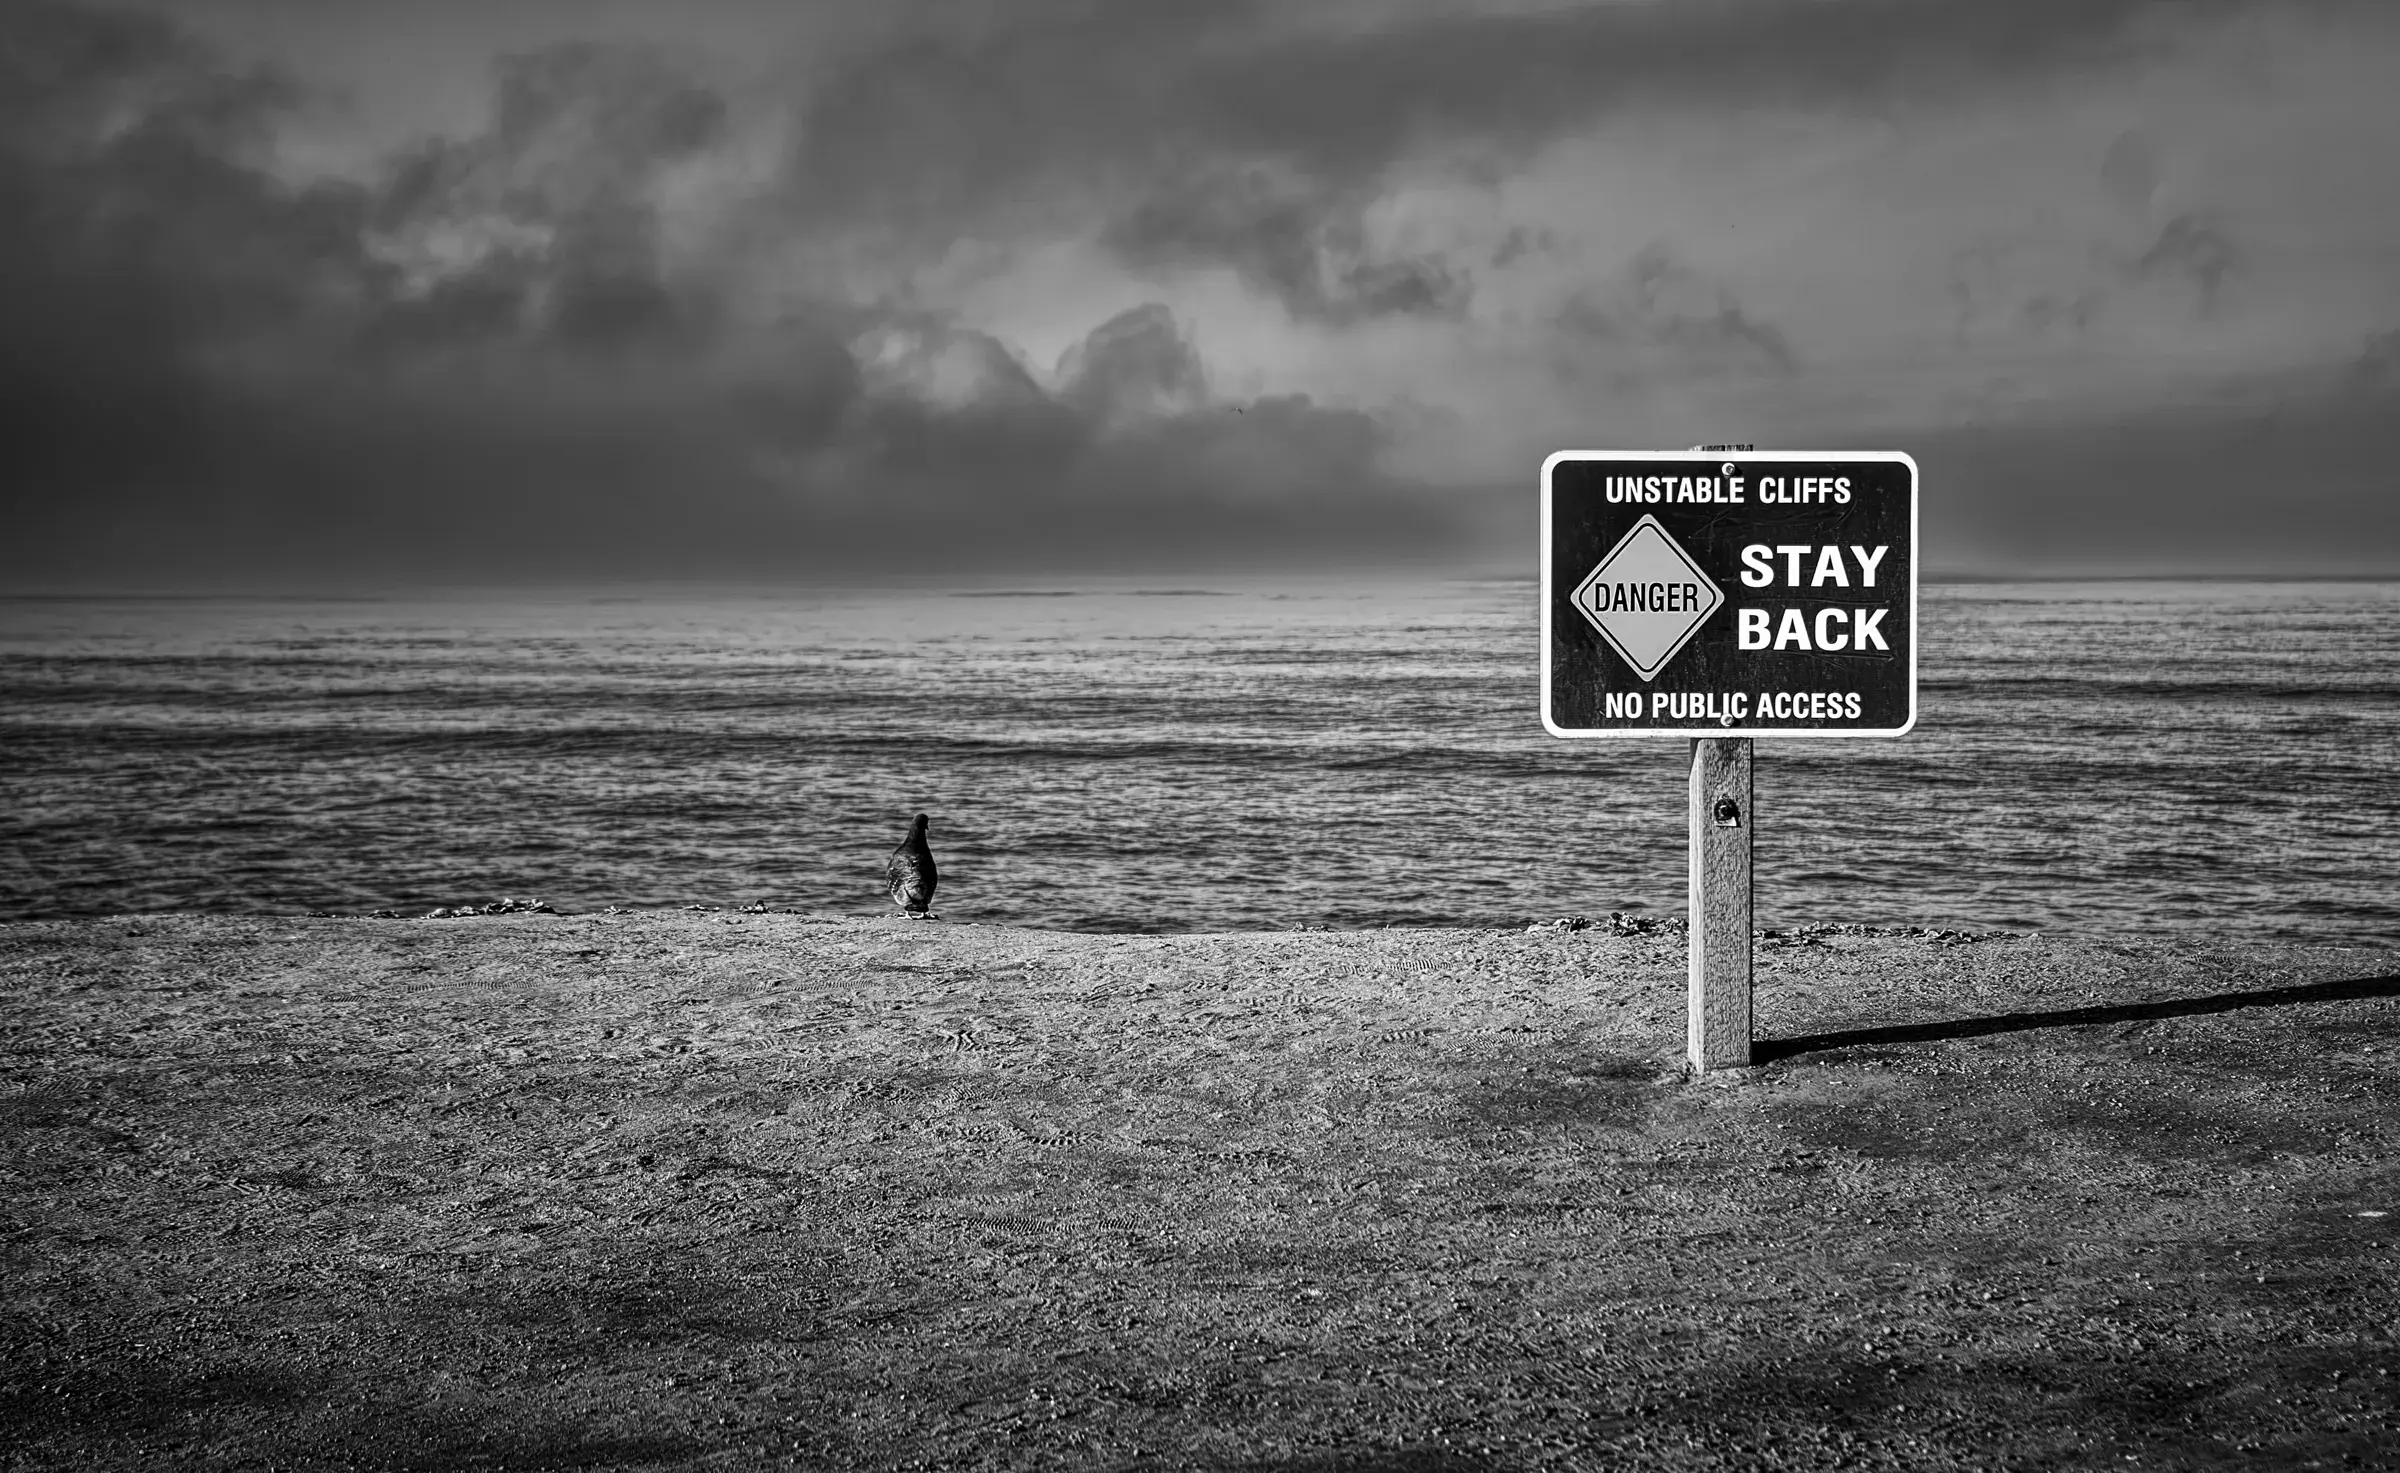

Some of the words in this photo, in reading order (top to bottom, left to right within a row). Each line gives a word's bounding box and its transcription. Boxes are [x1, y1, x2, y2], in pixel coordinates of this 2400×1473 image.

[1605, 476, 1745, 503] UNSTABLE
[1759, 476, 1851, 503] CLIFFS
[1740, 544, 1889, 588] STAY
[1595, 582, 1699, 612] DANGER
[1738, 608, 1890, 650] BACK
[1605, 692, 1643, 719] NO
[1652, 692, 1748, 719] PUBLIC
[1755, 692, 1861, 719] ACCESS
